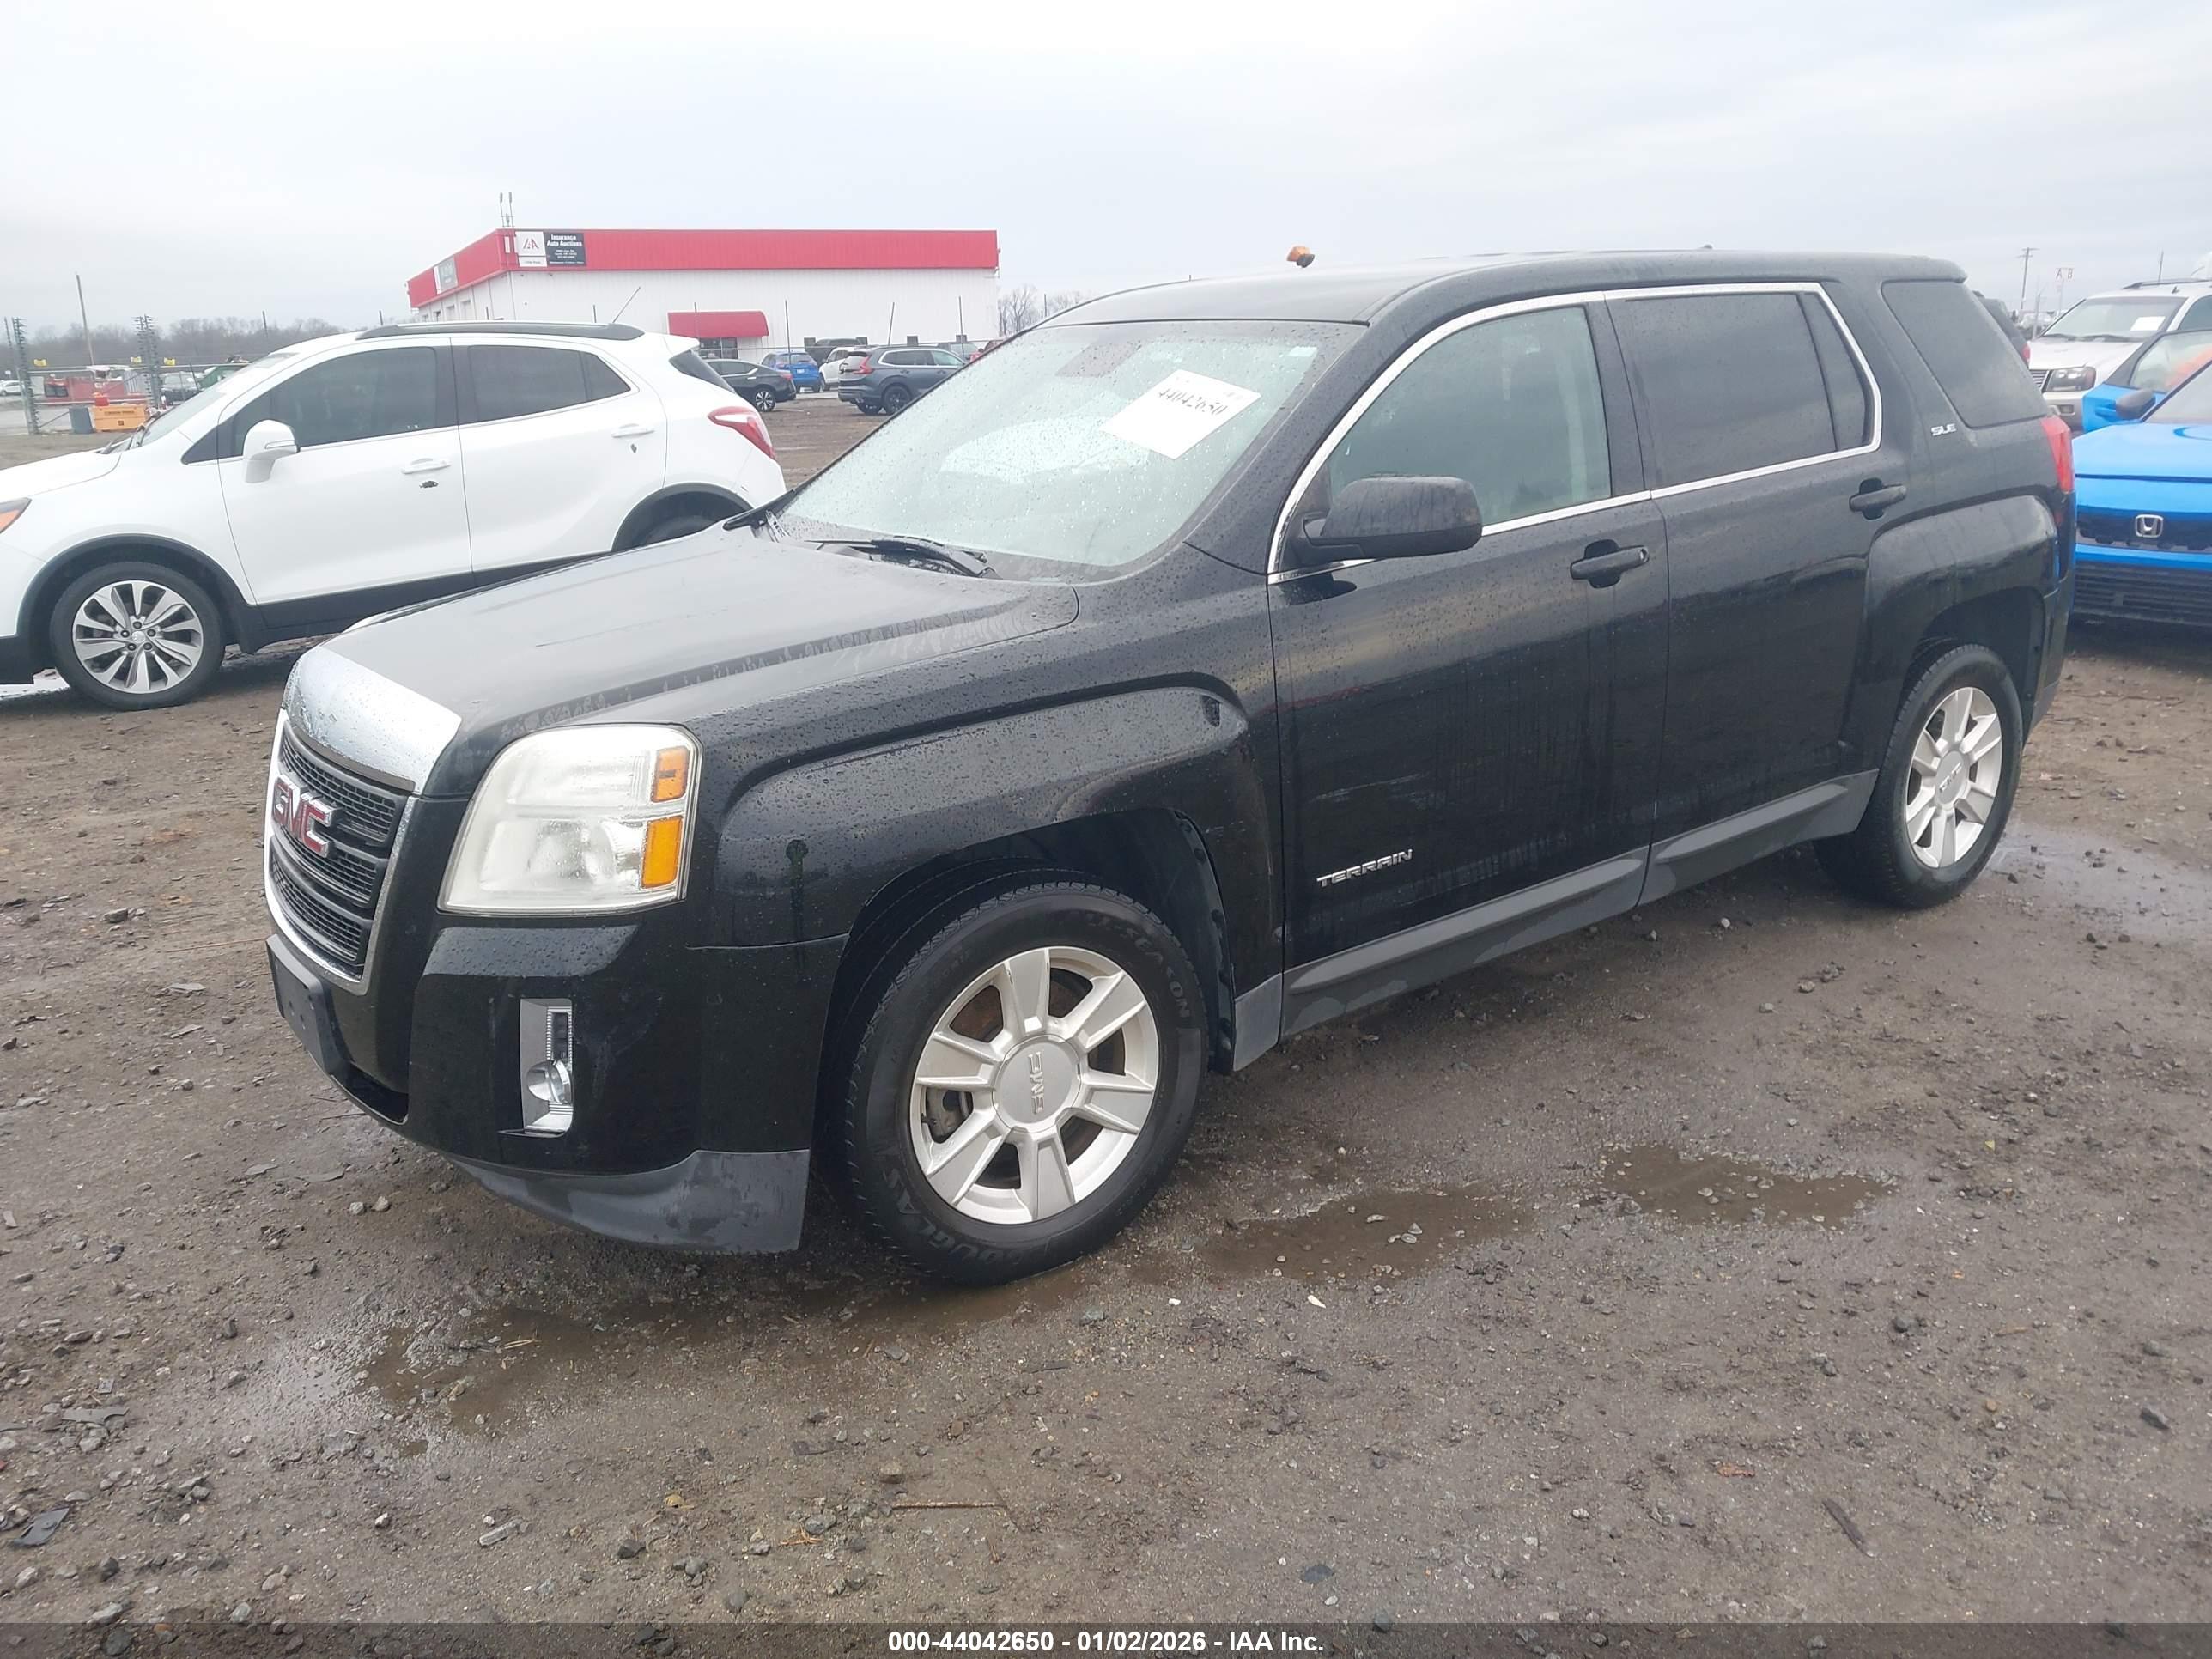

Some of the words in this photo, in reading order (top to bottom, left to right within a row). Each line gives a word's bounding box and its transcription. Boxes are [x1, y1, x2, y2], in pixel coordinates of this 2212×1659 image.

[272, 773, 335, 858] GMC
[1316, 848, 1413, 888] TERRAIN
[1027, 1050, 1045, 1115] GMC
